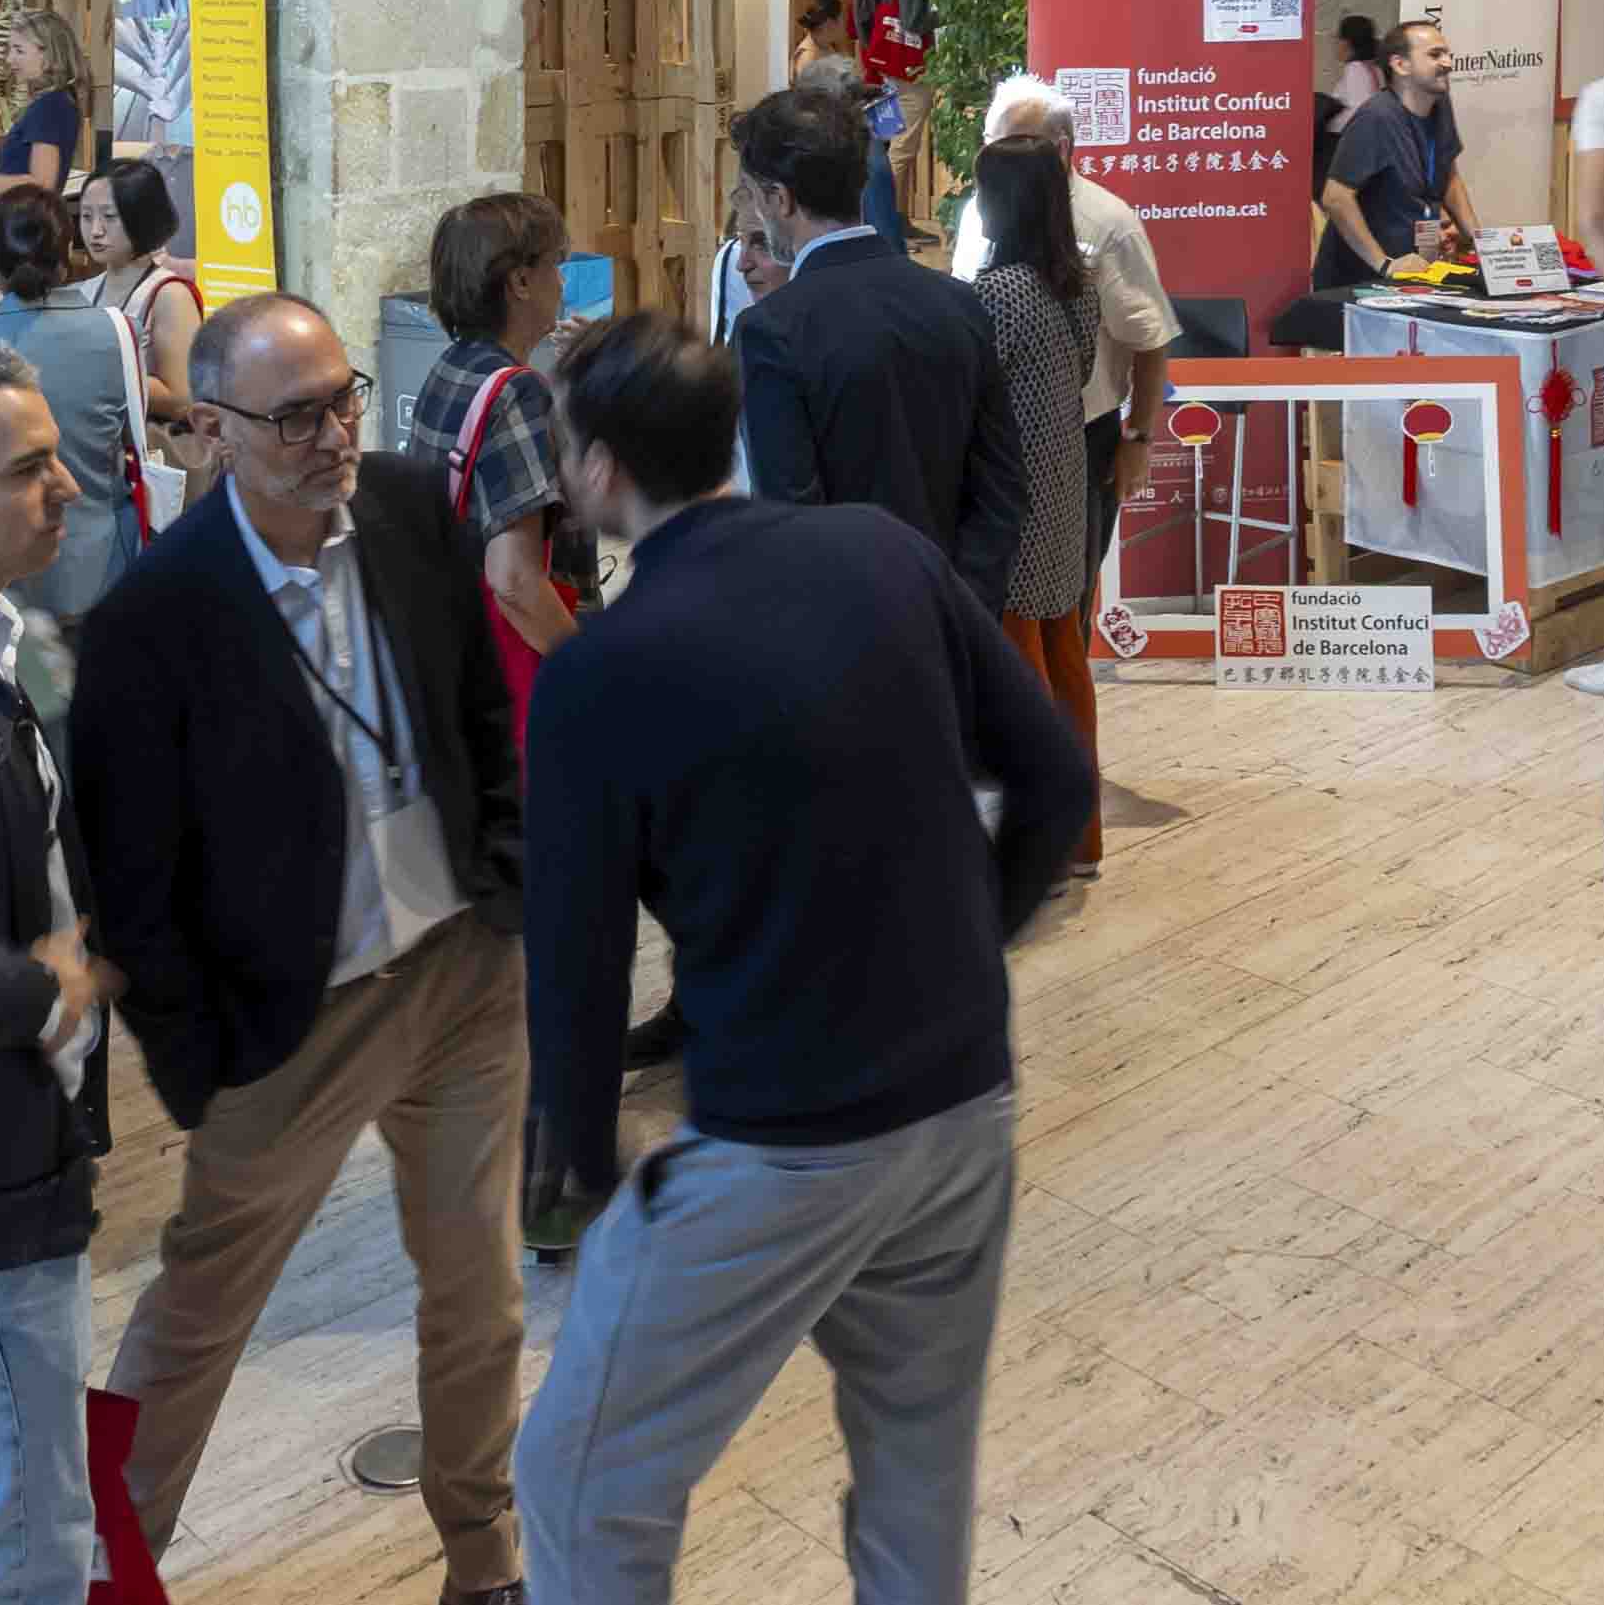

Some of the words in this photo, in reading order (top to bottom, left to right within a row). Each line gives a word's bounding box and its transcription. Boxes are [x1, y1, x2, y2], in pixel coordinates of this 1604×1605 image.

[1137, 66, 1217, 85] fundació
[1138, 93, 1210, 114] Institut
[1214, 91, 1291, 112] Confuci
[1137, 123, 1164, 142] de
[1168, 120, 1267, 141] Barcelona
[1079, 149, 1290, 177] 塞罗那孔子学院基金会
[1291, 590, 1361, 605] fundació
[1292, 615, 1356, 631] Institut
[1361, 614, 1429, 631] Confuci
[1292, 639, 1316, 656] de
[1320, 639, 1409, 656] Barcelona
